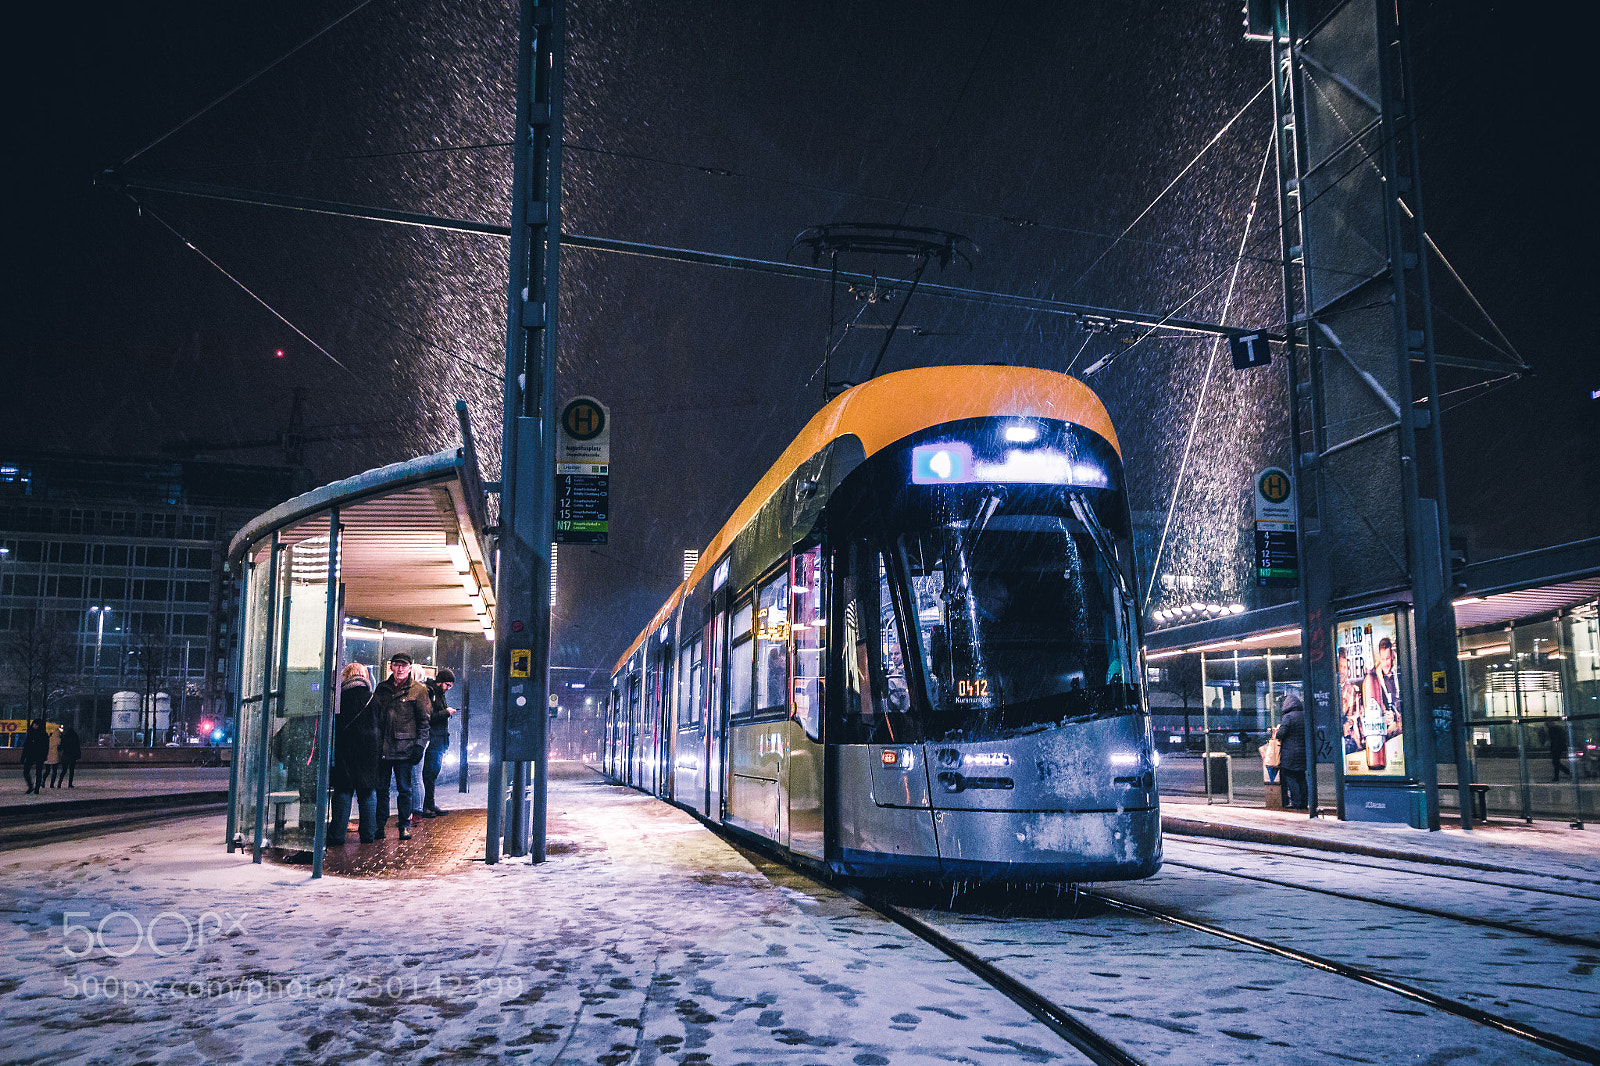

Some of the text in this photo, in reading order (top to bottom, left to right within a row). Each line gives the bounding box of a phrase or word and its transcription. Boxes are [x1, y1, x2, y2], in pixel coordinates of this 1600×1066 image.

[1239, 334, 1259, 361] T
[574, 407, 593, 432] H
[565, 475, 571, 485] 4
[565, 486, 571, 496] 7
[1268, 476, 1282, 496] H
[560, 498, 571, 508] 12
[560, 509, 571, 519] 15
[557, 520, 571, 530] N17
[1264, 531, 1270, 539] 4
[1264, 540, 1270, 549] 7
[1261, 549, 1270, 558] 12
[1261, 559, 1271, 568] 15
[1260, 568, 1271, 577] N17
[1344, 626, 1363, 645] BLEIB
[1346, 656, 1367, 679] BIER
[958, 679, 989, 697] 0412
